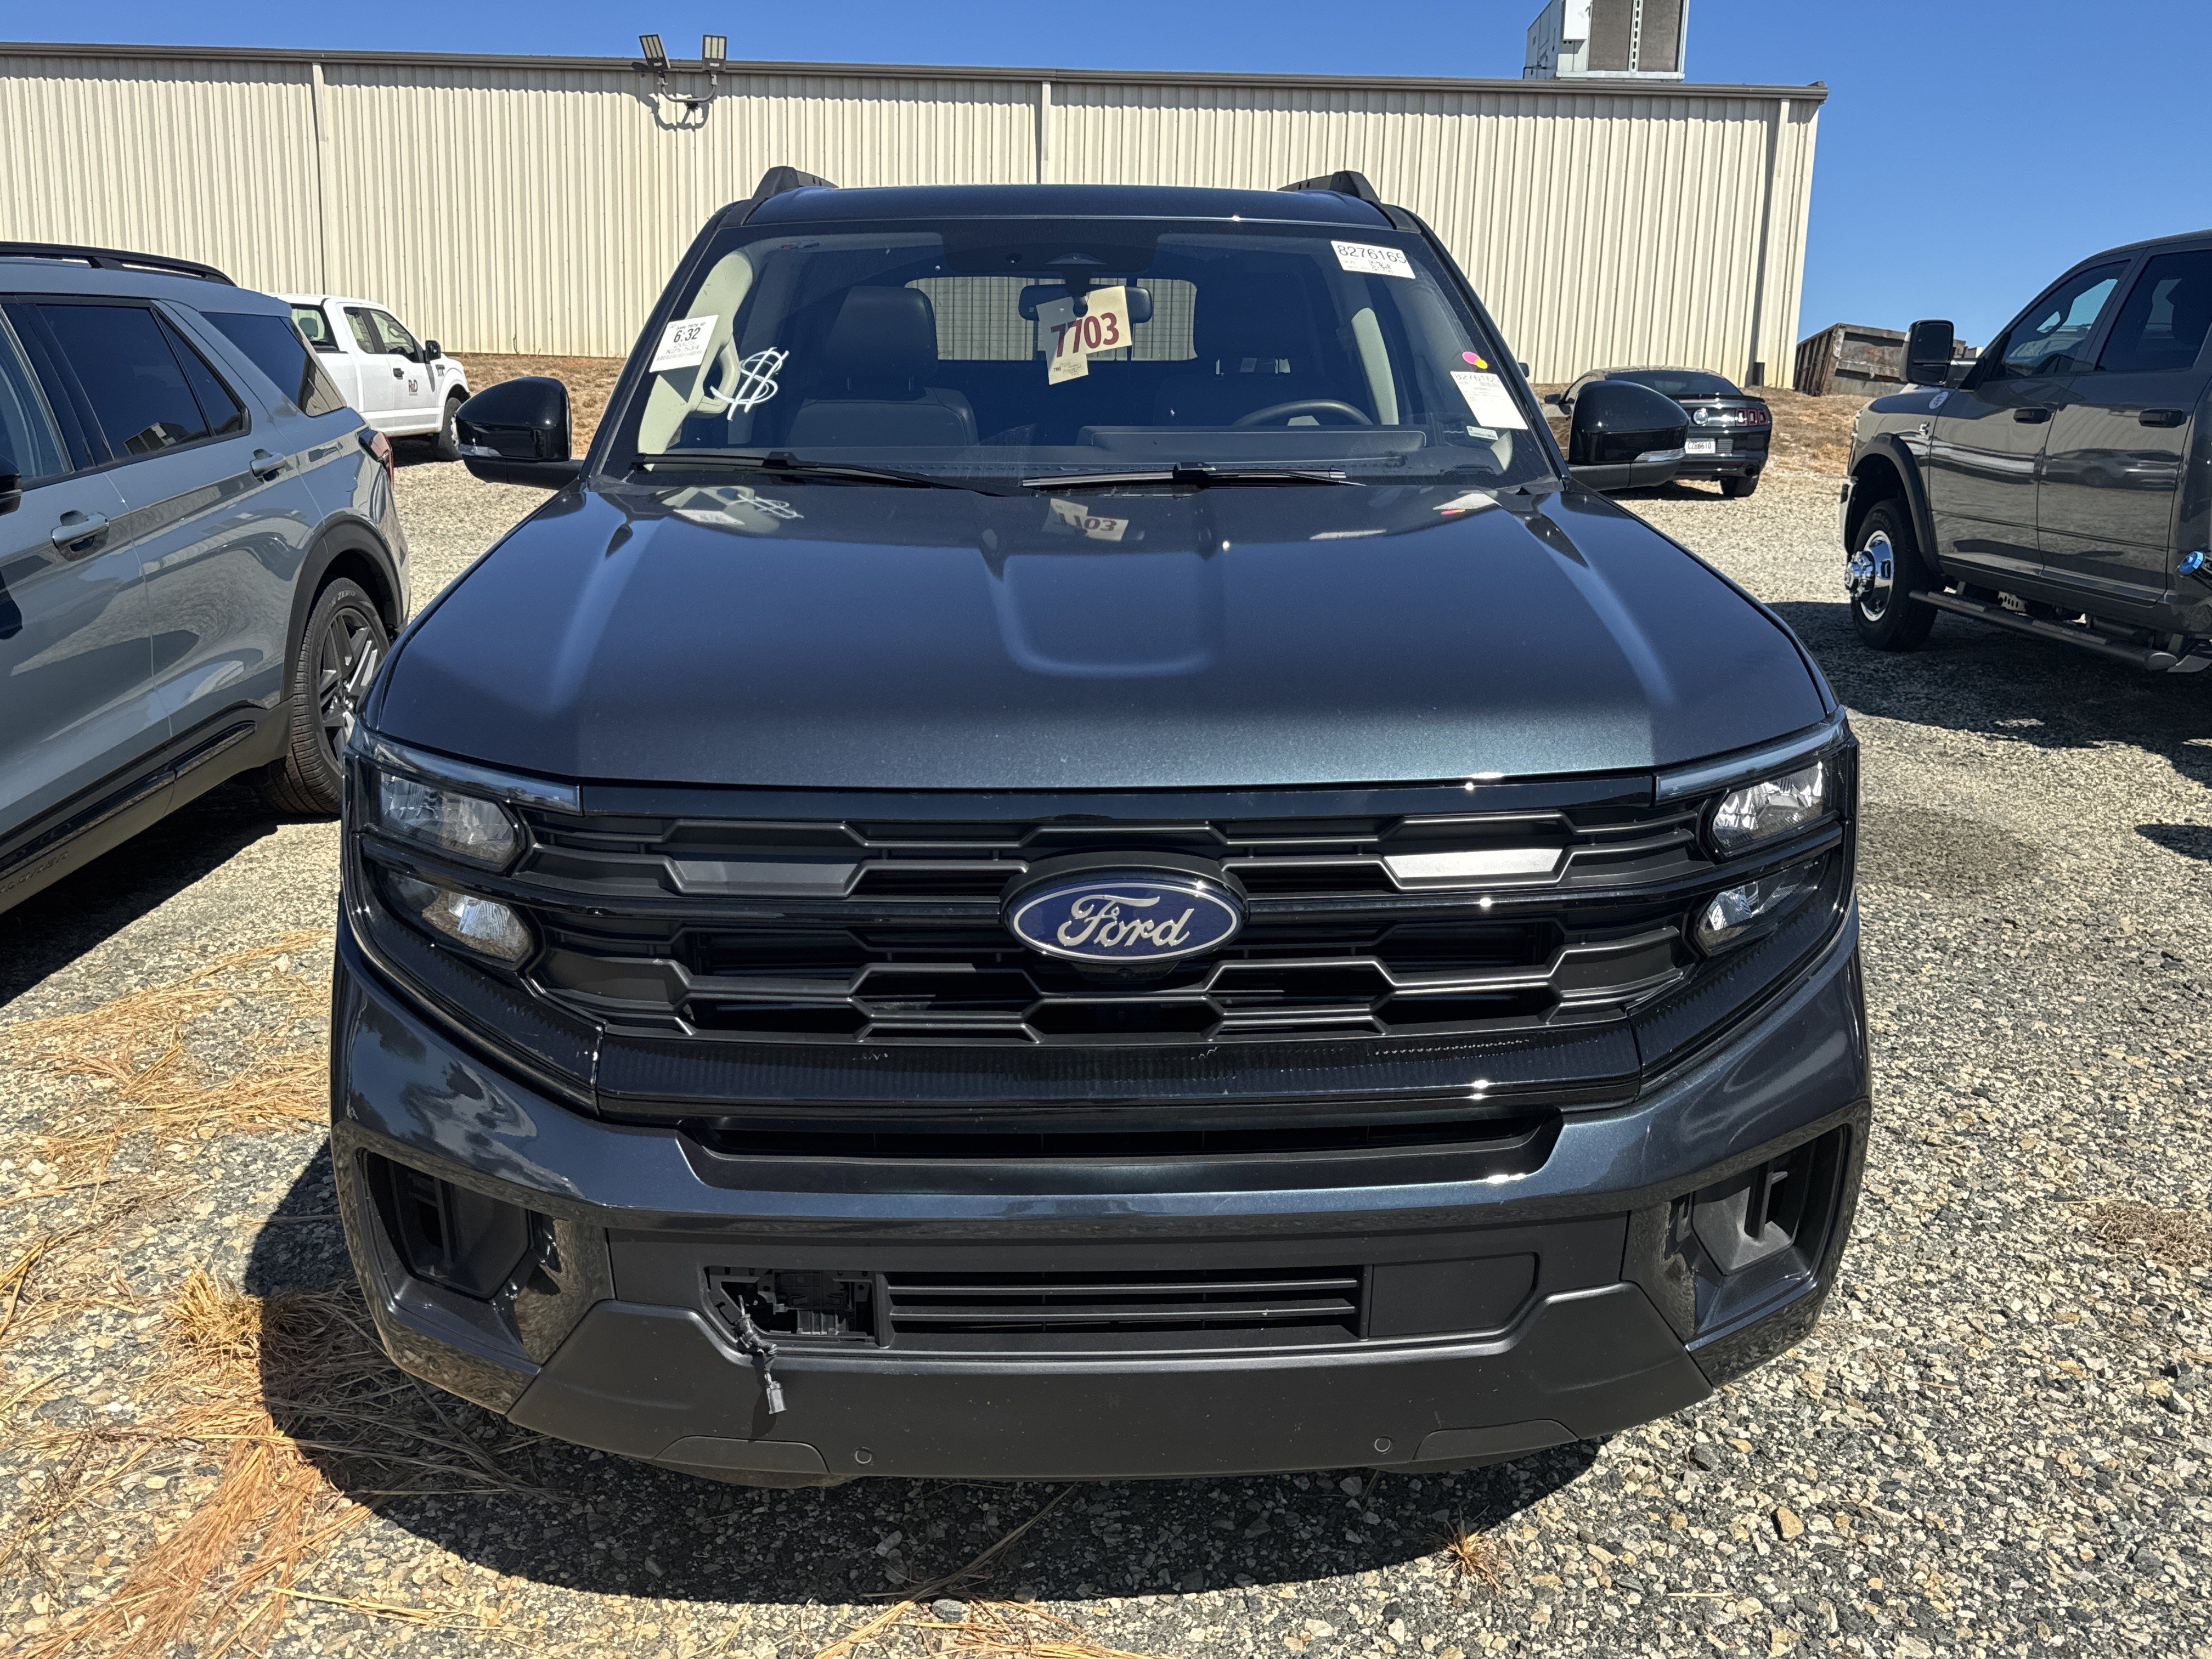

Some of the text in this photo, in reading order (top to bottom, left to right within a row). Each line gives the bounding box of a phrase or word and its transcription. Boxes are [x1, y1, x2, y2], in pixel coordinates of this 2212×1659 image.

[1337, 245, 1407, 264] 8276165
[673, 327, 701, 343] 6:32
[1051, 312, 1120, 358] 7703
[1057, 894, 1195, 947] Ford
